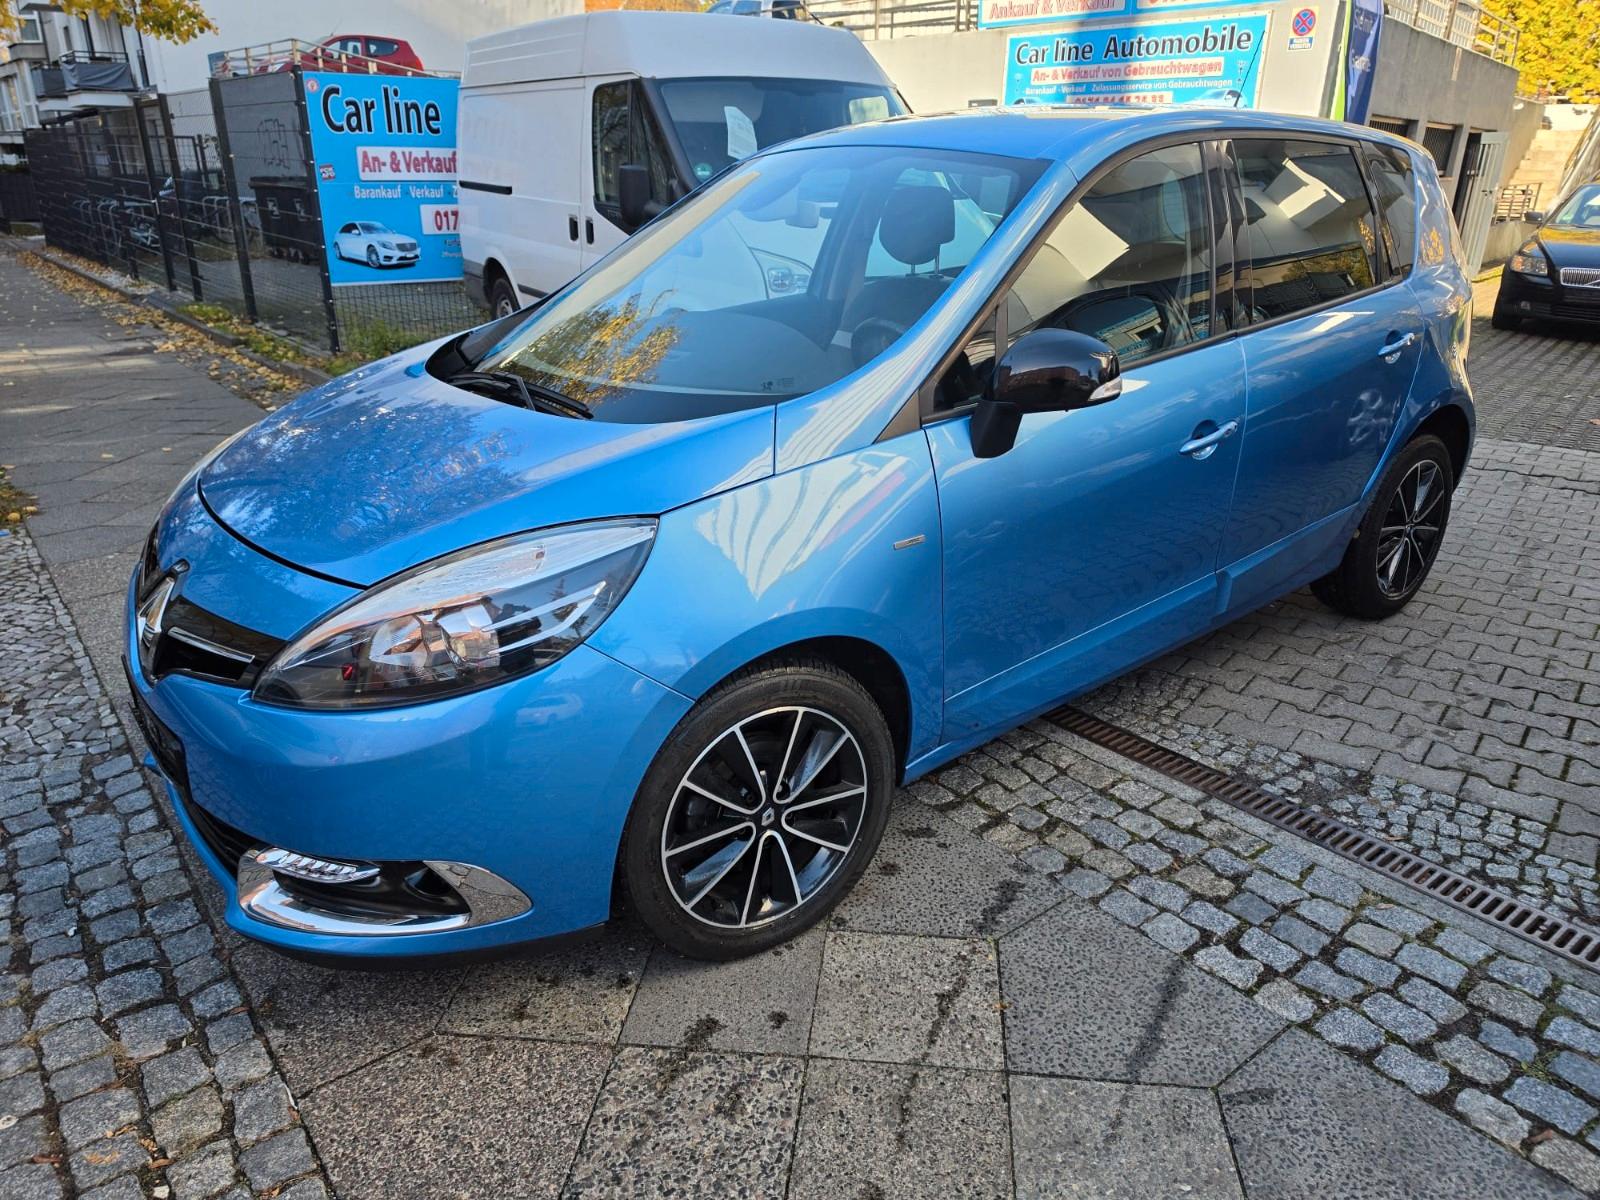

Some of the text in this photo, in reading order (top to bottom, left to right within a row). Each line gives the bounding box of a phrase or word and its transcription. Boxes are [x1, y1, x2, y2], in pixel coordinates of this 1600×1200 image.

[1016, 25, 1252, 64] Car line Automobile
[1061, 66, 1101, 80] Verkauf
[1102, 67, 1121, 78] von
[1123, 60, 1222, 77] Gebrauchtwagen
[1168, 78, 1232, 90] Gebrauchtwagen
[322, 85, 441, 135] Car line
[361, 150, 387, 173] An-
[390, 150, 401, 173] &
[402, 151, 457, 174] Verkauf
[354, 184, 401, 199] Barankauf
[409, 185, 444, 199] Verkauf
